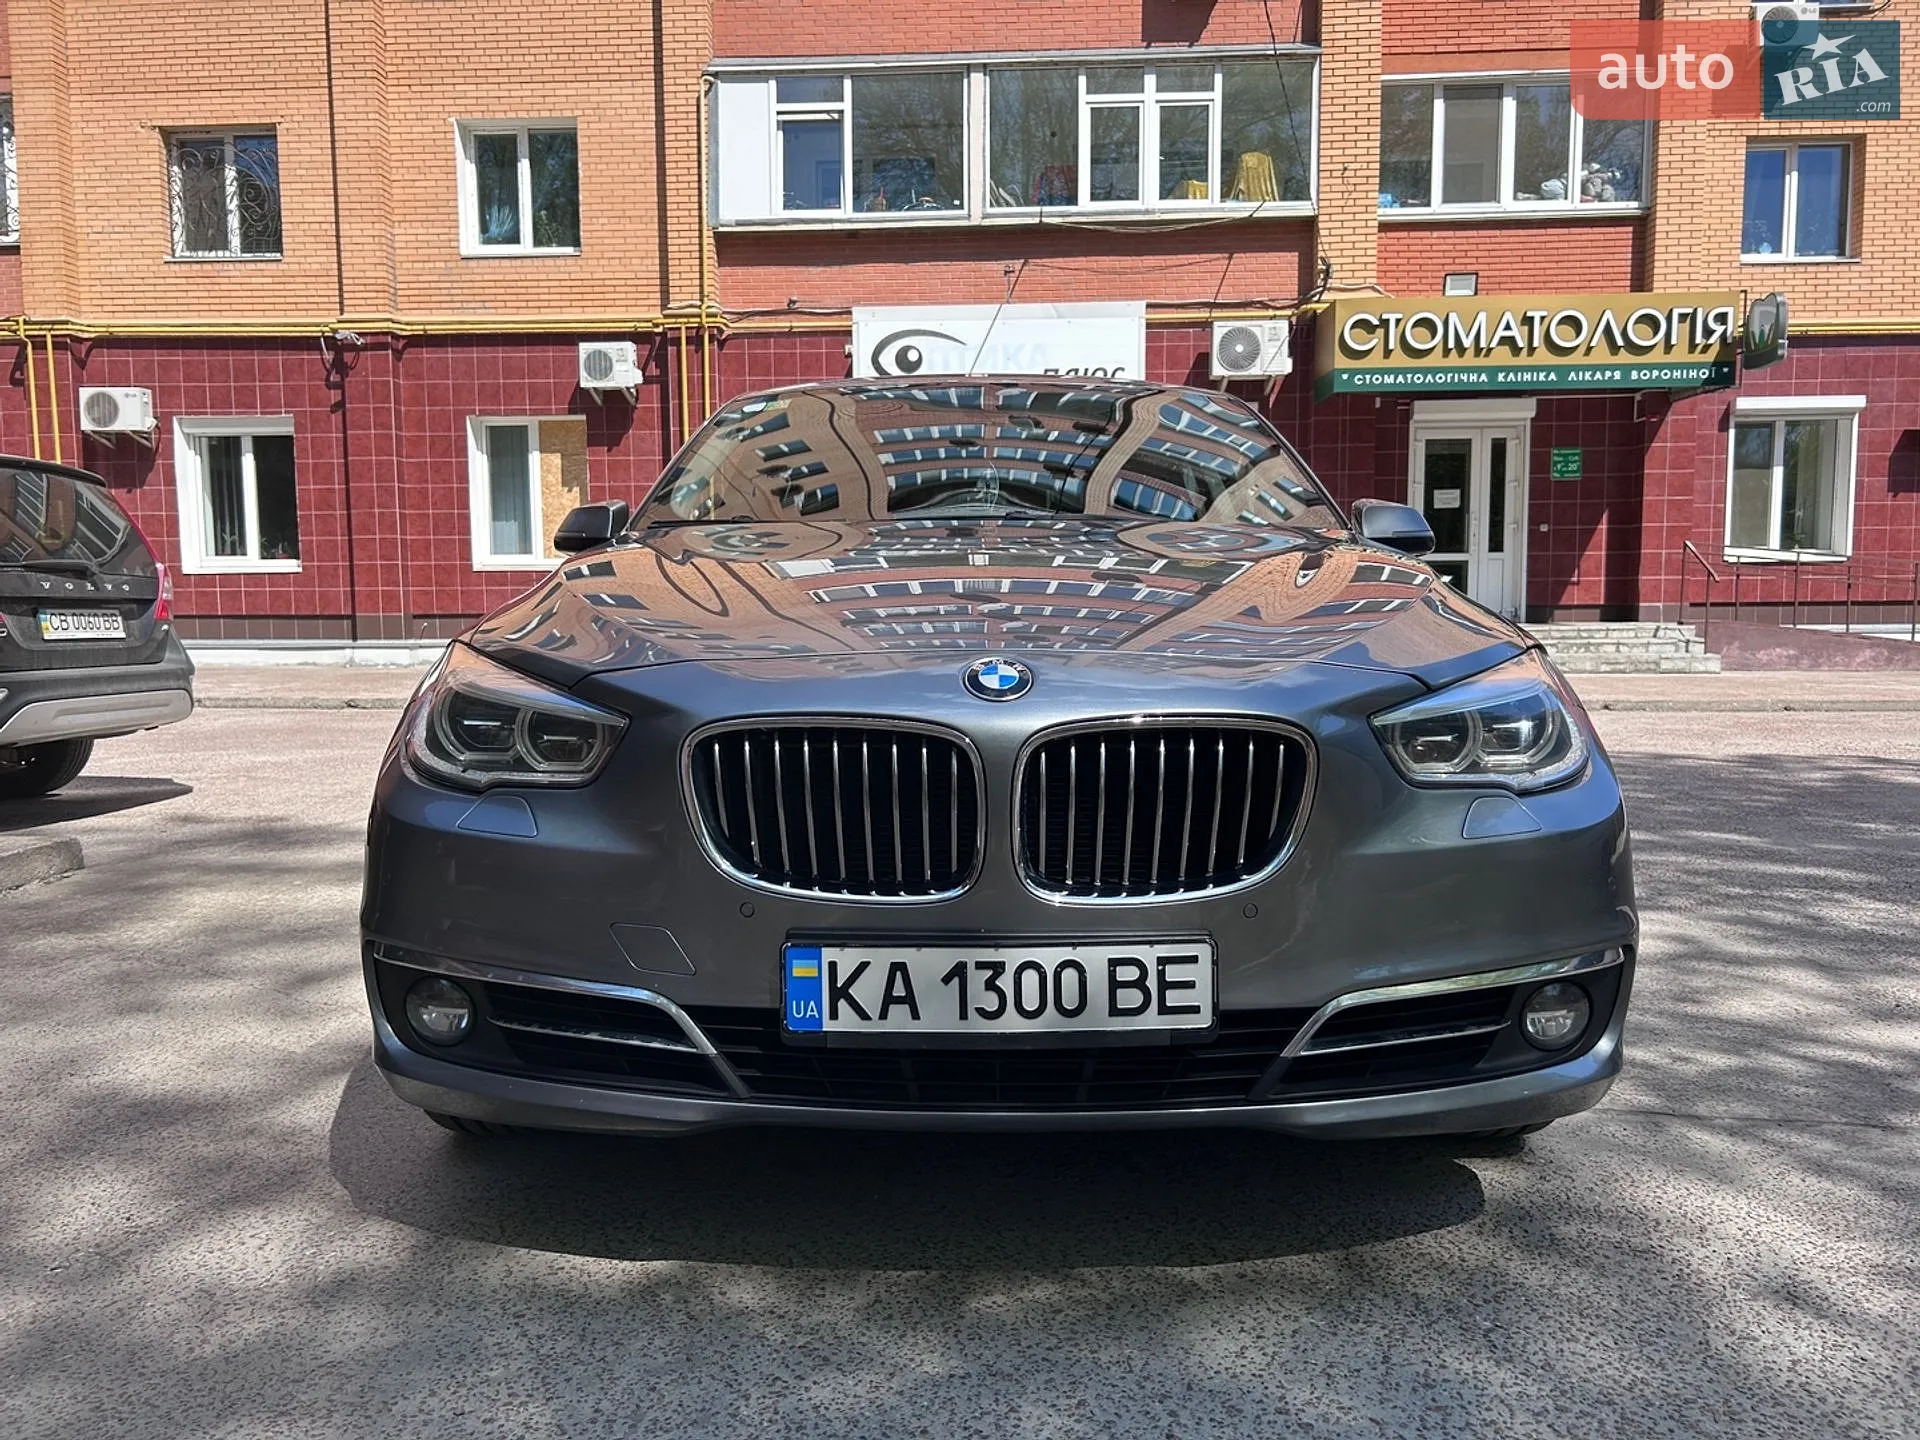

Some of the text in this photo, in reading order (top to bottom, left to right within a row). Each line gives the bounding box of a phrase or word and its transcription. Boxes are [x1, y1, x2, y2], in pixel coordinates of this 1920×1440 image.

[1343, 306, 1734, 351] СТОМАТОЛОГІЯ
[1354, 372, 1488, 385] СТОМАТОЛОГІЧНА
[1497, 371, 1557, 383] КЛІНІКА
[1568, 369, 1621, 381] ЛІКАРЯ
[40, 581, 130, 592] VOLVO
[72, 612, 101, 631] 0060
[828, 954, 1201, 1021] KA 1300 BE
[792, 1001, 819, 1019] UA
